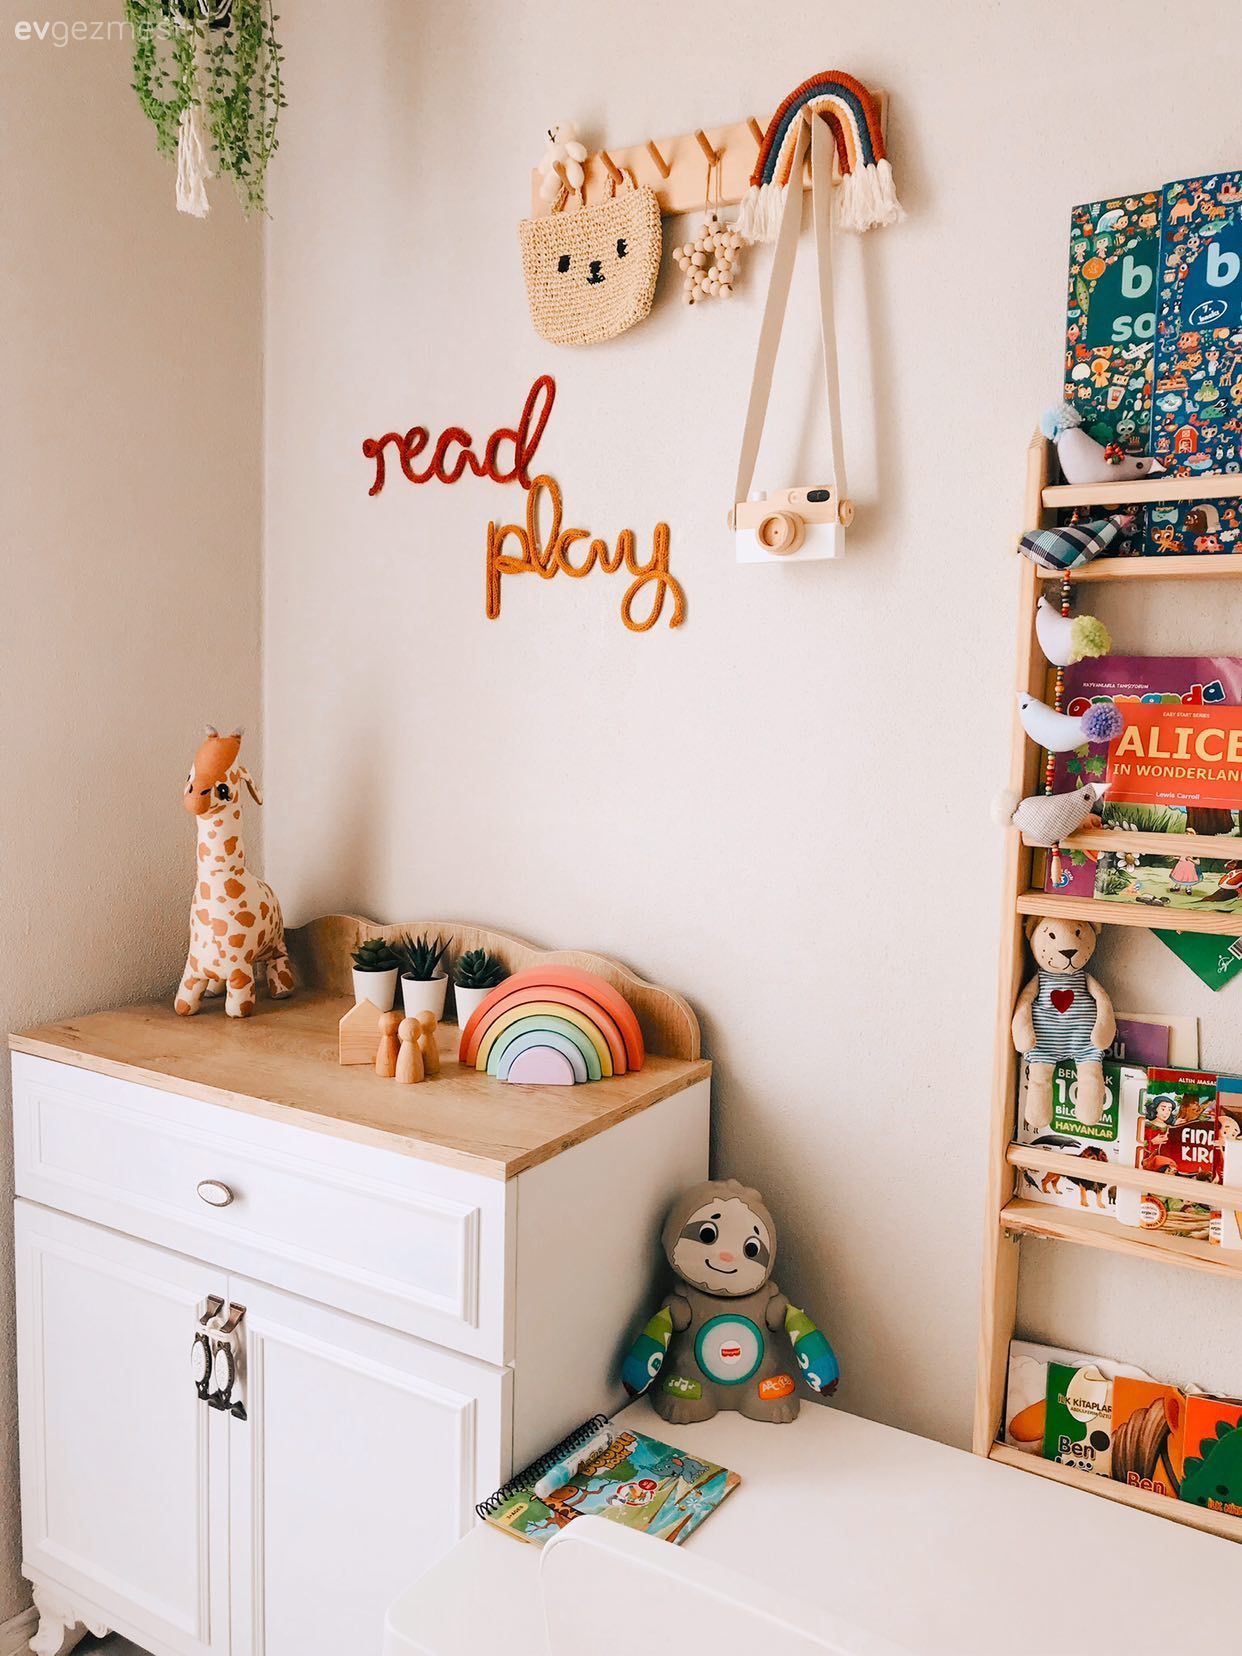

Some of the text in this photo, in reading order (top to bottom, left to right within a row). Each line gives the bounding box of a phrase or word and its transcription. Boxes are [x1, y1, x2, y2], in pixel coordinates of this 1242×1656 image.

[362, 374, 556, 497] read
[486, 474, 688, 633] play
[1115, 725, 1242, 763] ALICE
[1113, 763, 1242, 782] IN WONDERLAN
[1155, 791, 1201, 800] Lewis Carroll
[1055, 1120, 1113, 1139] HAYVANLAR
[1058, 1435, 1096, 1461] Ben
[1127, 1471, 1166, 1497] Ben
